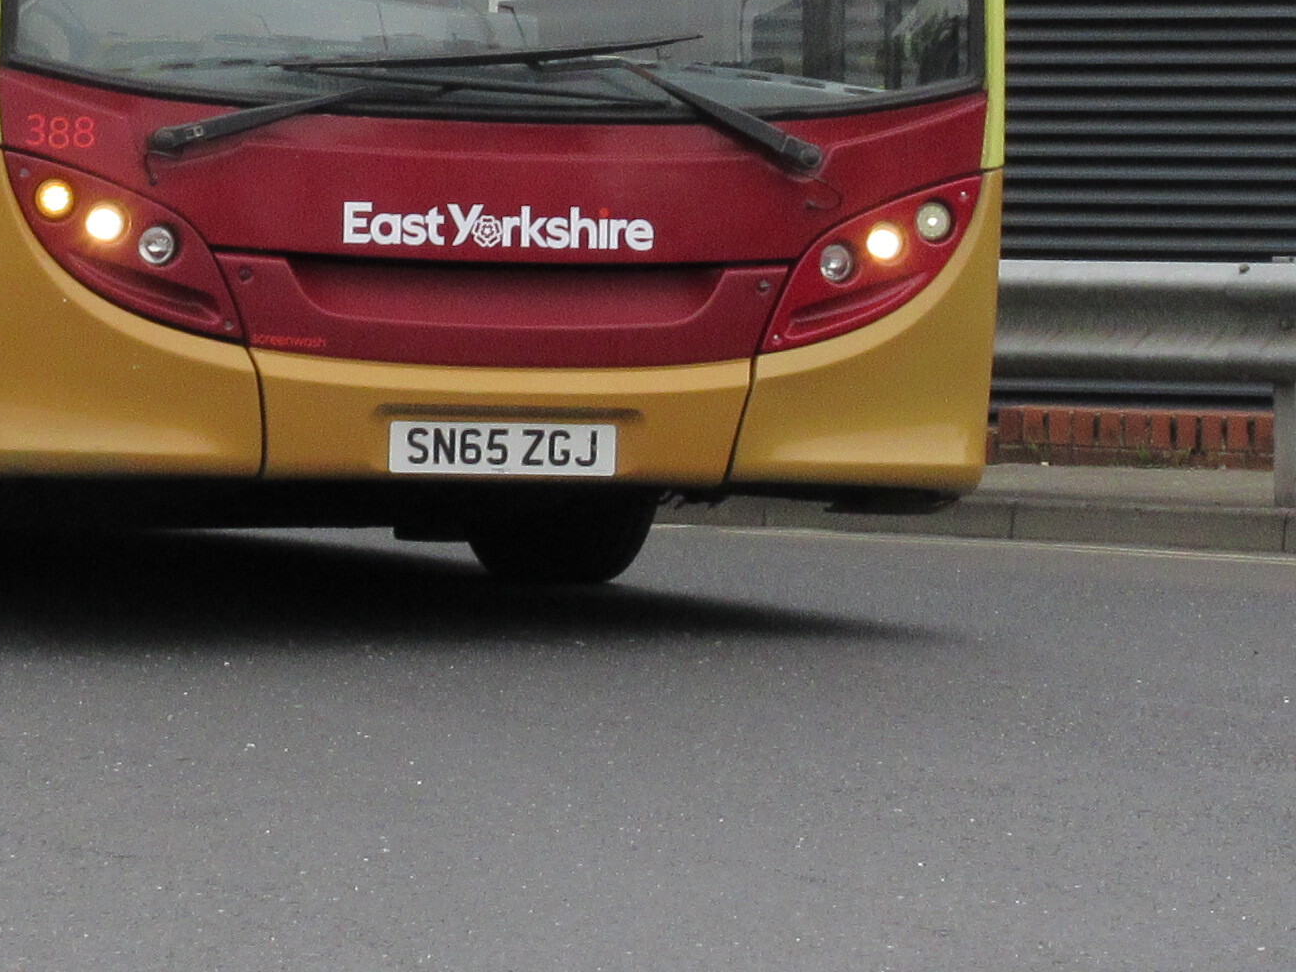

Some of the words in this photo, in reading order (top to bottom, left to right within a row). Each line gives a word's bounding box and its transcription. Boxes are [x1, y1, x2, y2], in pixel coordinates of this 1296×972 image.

[25, 114, 95, 149] 388
[407, 427, 509, 465] SN65
[521, 429, 599, 467] ZGJ
